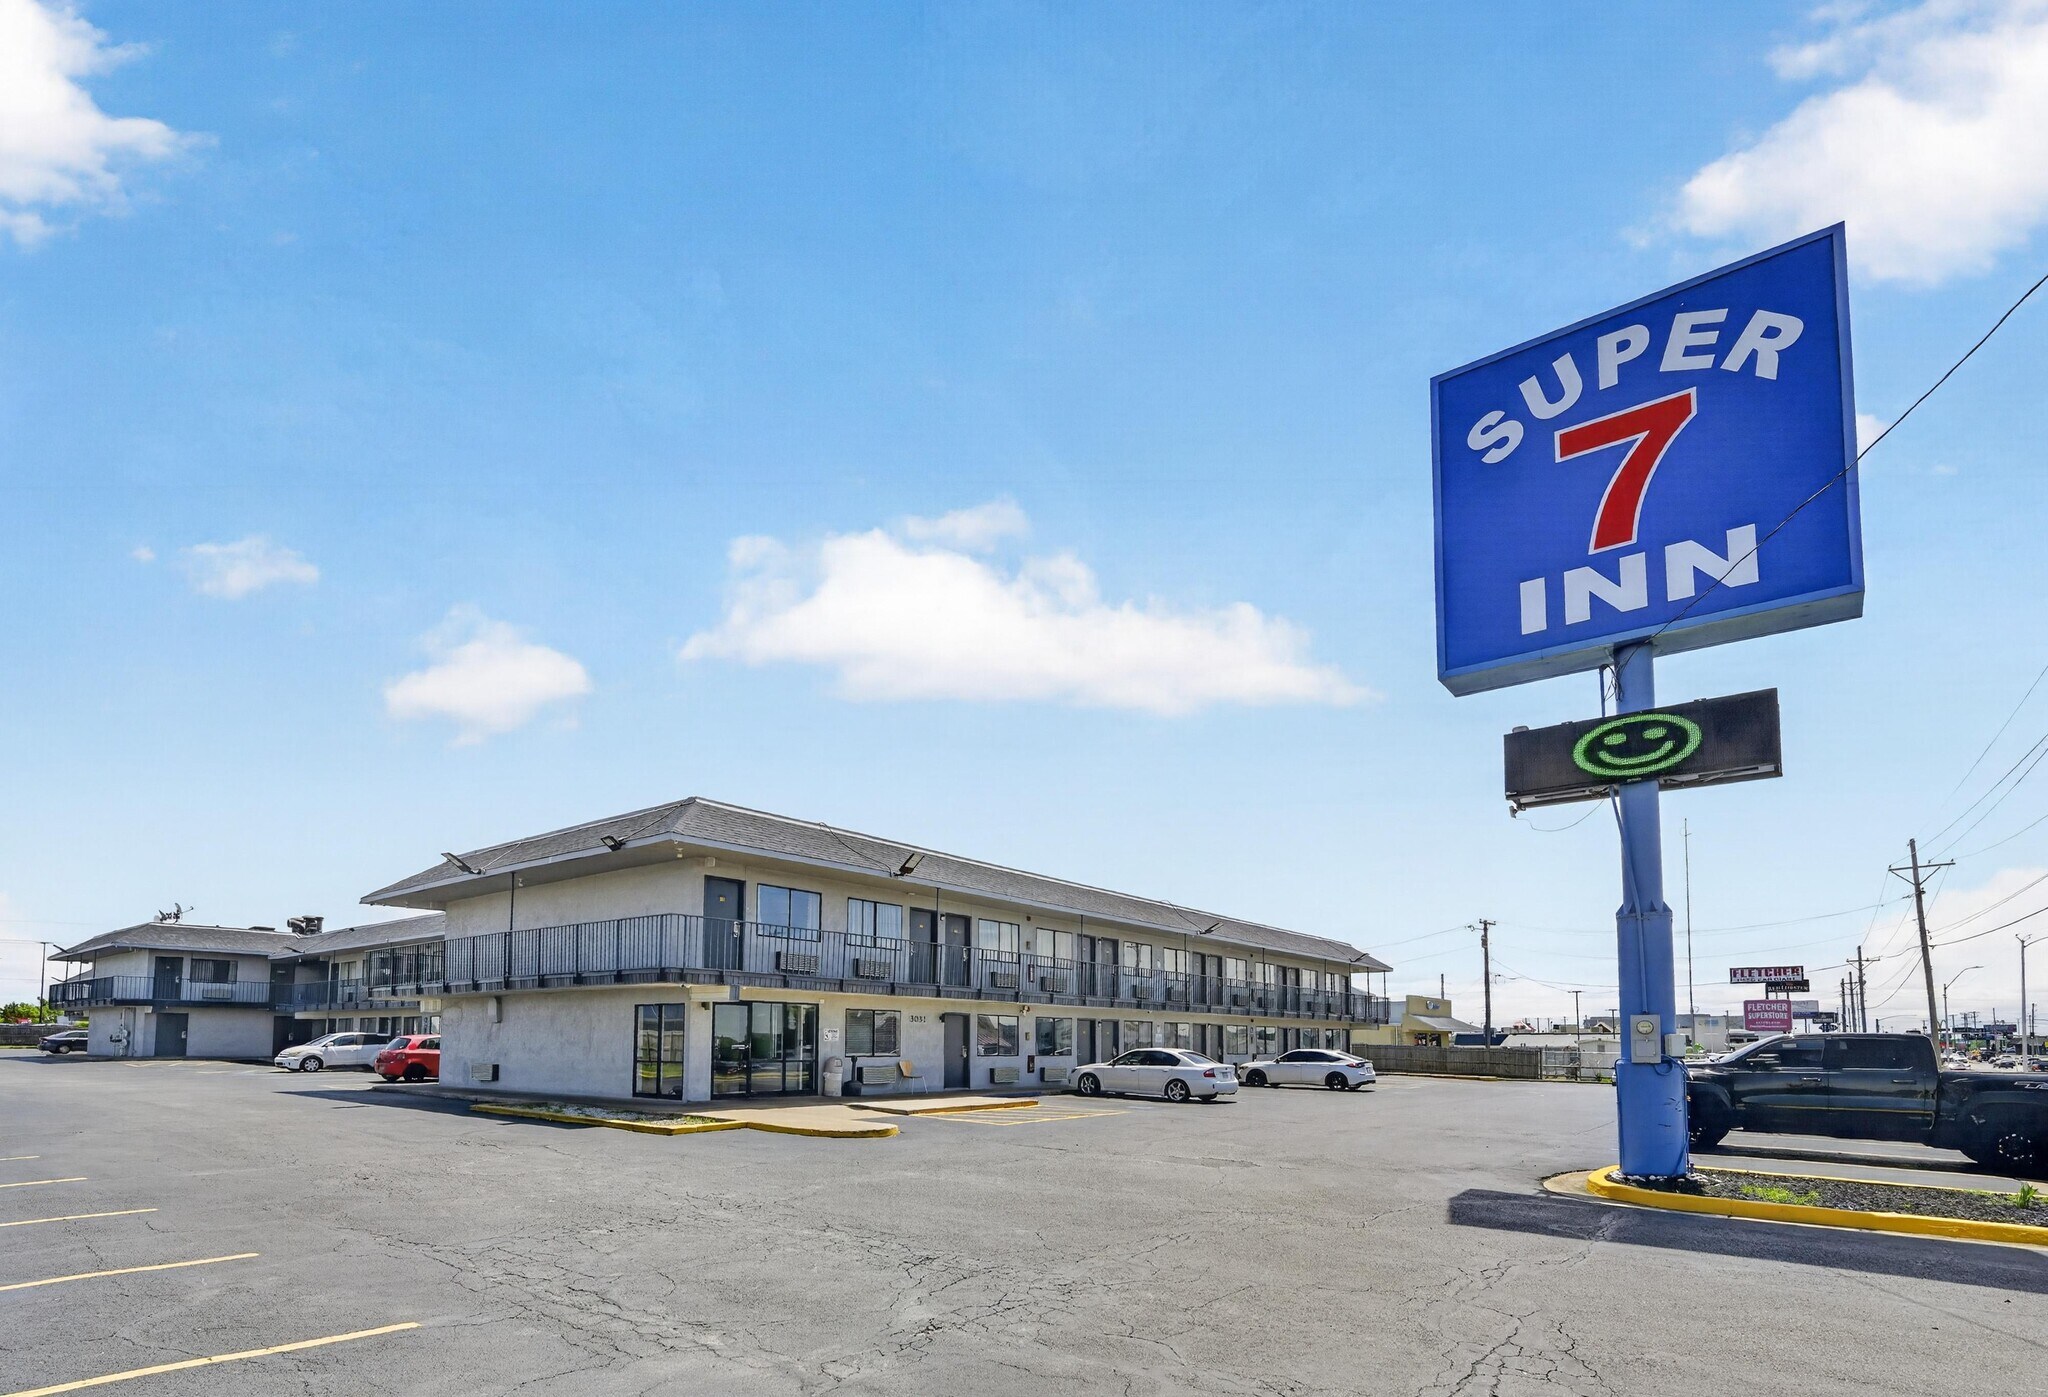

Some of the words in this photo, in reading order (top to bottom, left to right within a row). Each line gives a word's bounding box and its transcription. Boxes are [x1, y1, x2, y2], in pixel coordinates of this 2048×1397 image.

[1466, 308, 1804, 464] SUPER
[1554, 386, 1697, 556] 7
[1519, 523, 1760, 636] INN
[1732, 967, 1800, 977] FLETCHER
[1747, 1003, 1788, 1012] FLETCHER
[1747, 1012, 1788, 1020] SUPERSTORE
